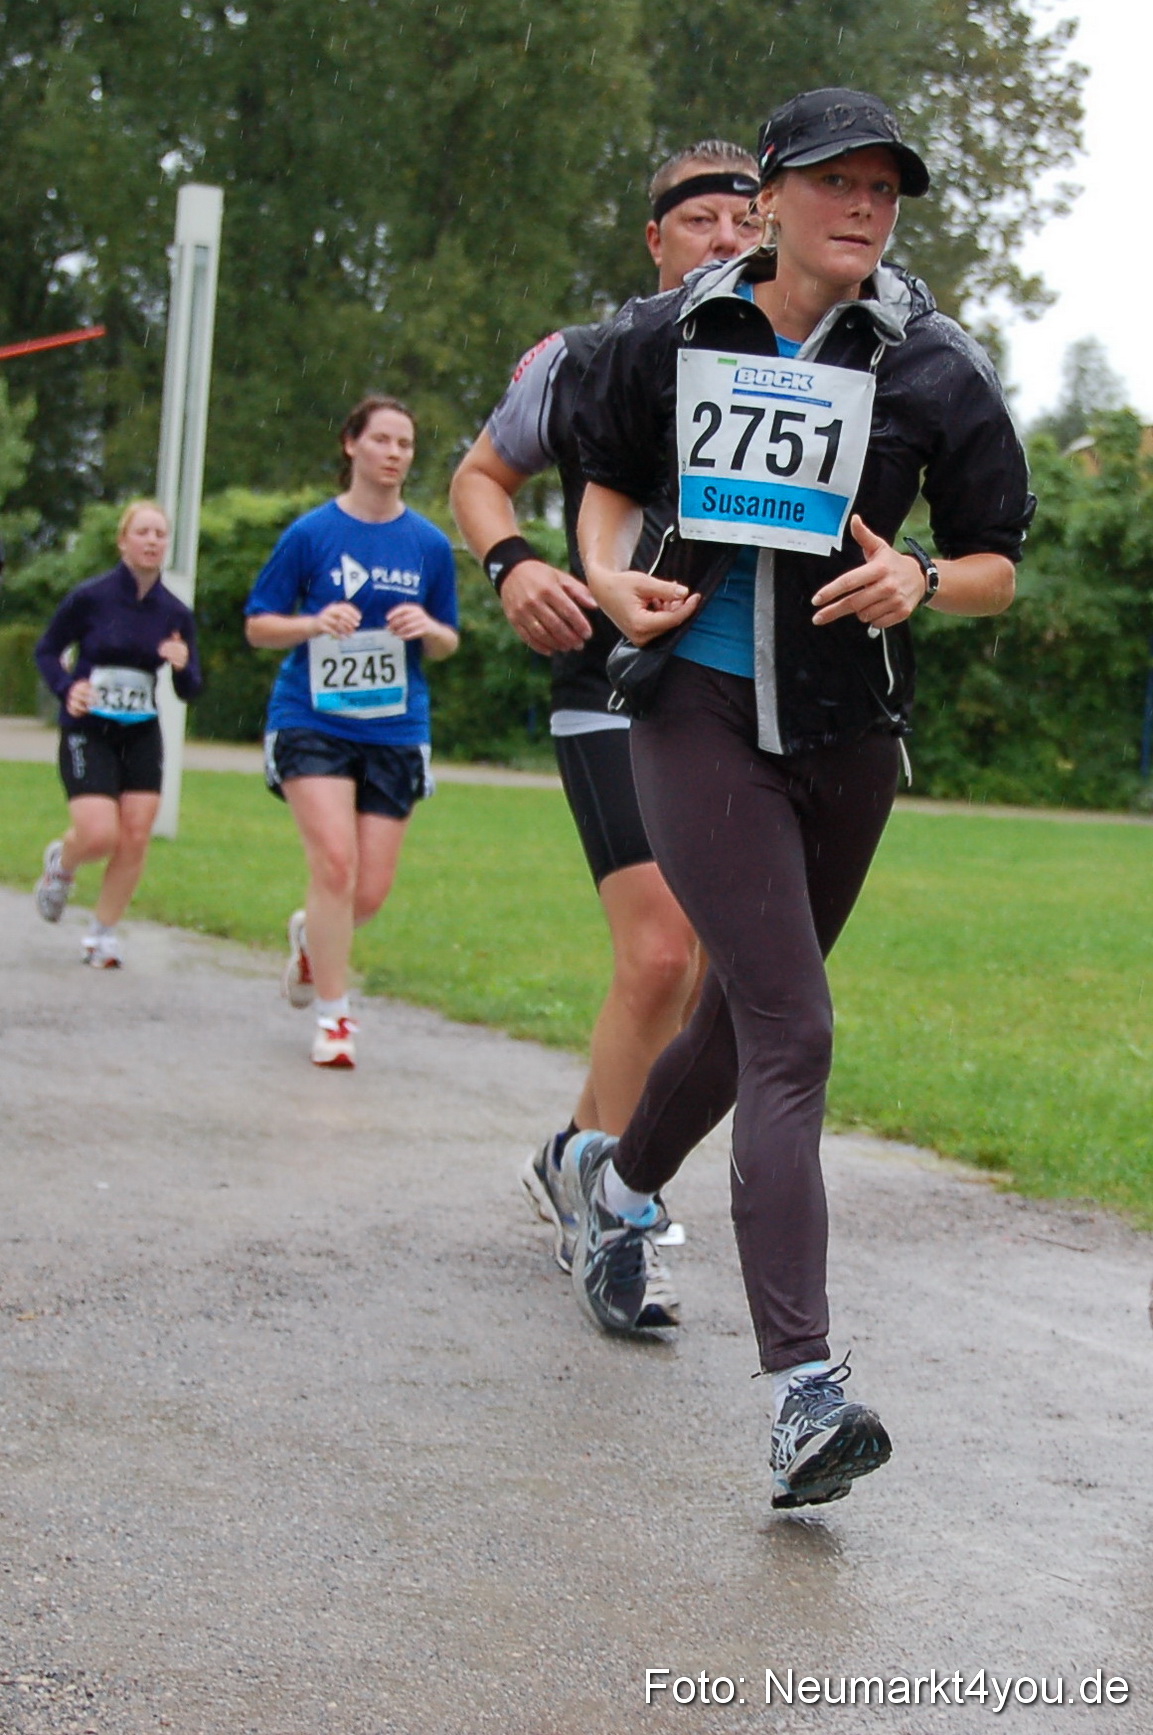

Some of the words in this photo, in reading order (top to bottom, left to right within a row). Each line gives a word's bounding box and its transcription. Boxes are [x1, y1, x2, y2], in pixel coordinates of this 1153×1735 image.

[734, 367, 814, 391] BOCK
[689, 401, 843, 485] 2751
[702, 486, 805, 523] Susanne
[371, 567, 420, 588] PLAST
[322, 654, 396, 688] 2245
